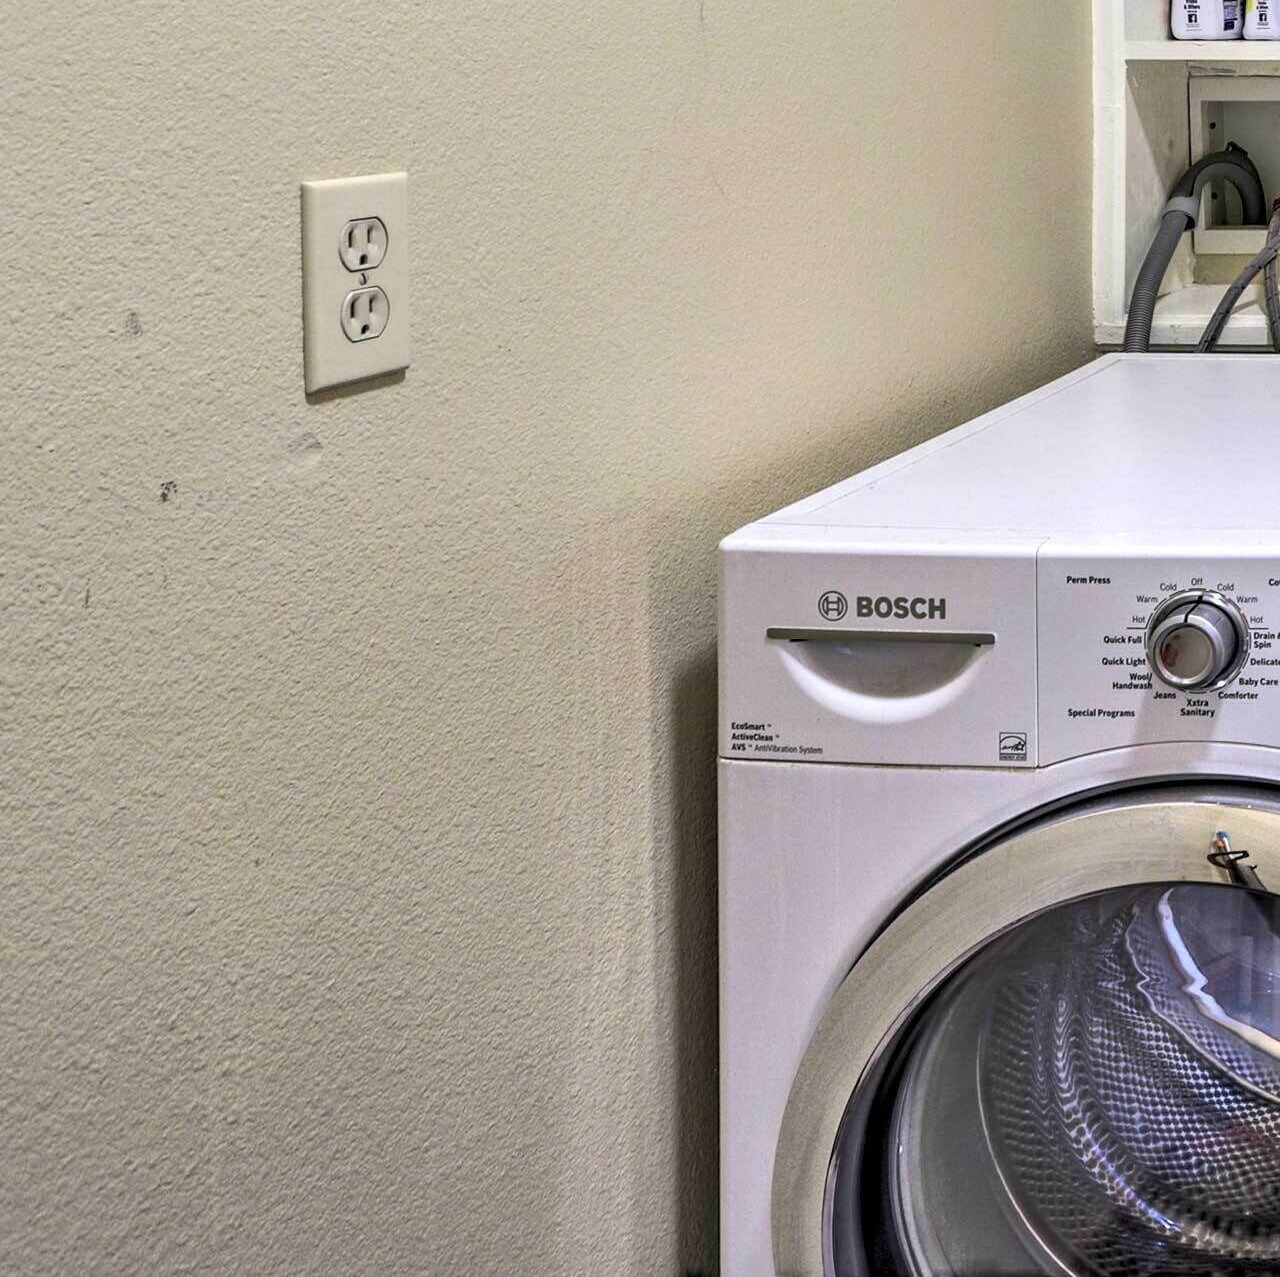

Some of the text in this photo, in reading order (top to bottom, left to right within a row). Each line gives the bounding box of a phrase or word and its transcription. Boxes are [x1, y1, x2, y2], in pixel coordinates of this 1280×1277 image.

[1066, 576, 1111, 585] Perm Press
[1191, 578, 1203, 586] Off
[1160, 583, 1177, 592] Cold
[1217, 583, 1235, 592] Cold
[1137, 595, 1158, 604] Warm
[1236, 595, 1258, 604] Warm
[856, 597, 946, 620] BOSCH
[1132, 615, 1146, 623] Hot
[1250, 615, 1264, 623] Hot
[1103, 636, 1143, 645] Quick Full
[1253, 632, 1275, 640] Drain
[1253, 640, 1272, 650] Spin
[1102, 657, 1146, 667] Quick Light
[1112, 681, 1153, 690] Handwash
[1239, 678, 1279, 688] Baby Care
[1153, 692, 1177, 700] Jeans
[1218, 691, 1259, 700] Comforter
[1186, 699, 1209, 707] Xxtra
[1068, 709, 1135, 718] Special Programs
[1180, 708, 1216, 718] Sanitary
[731, 723, 765, 731] EcoSmart
[731, 732, 774, 742] ActiveClean
[731, 743, 823, 755] AVS AntiVibration System
